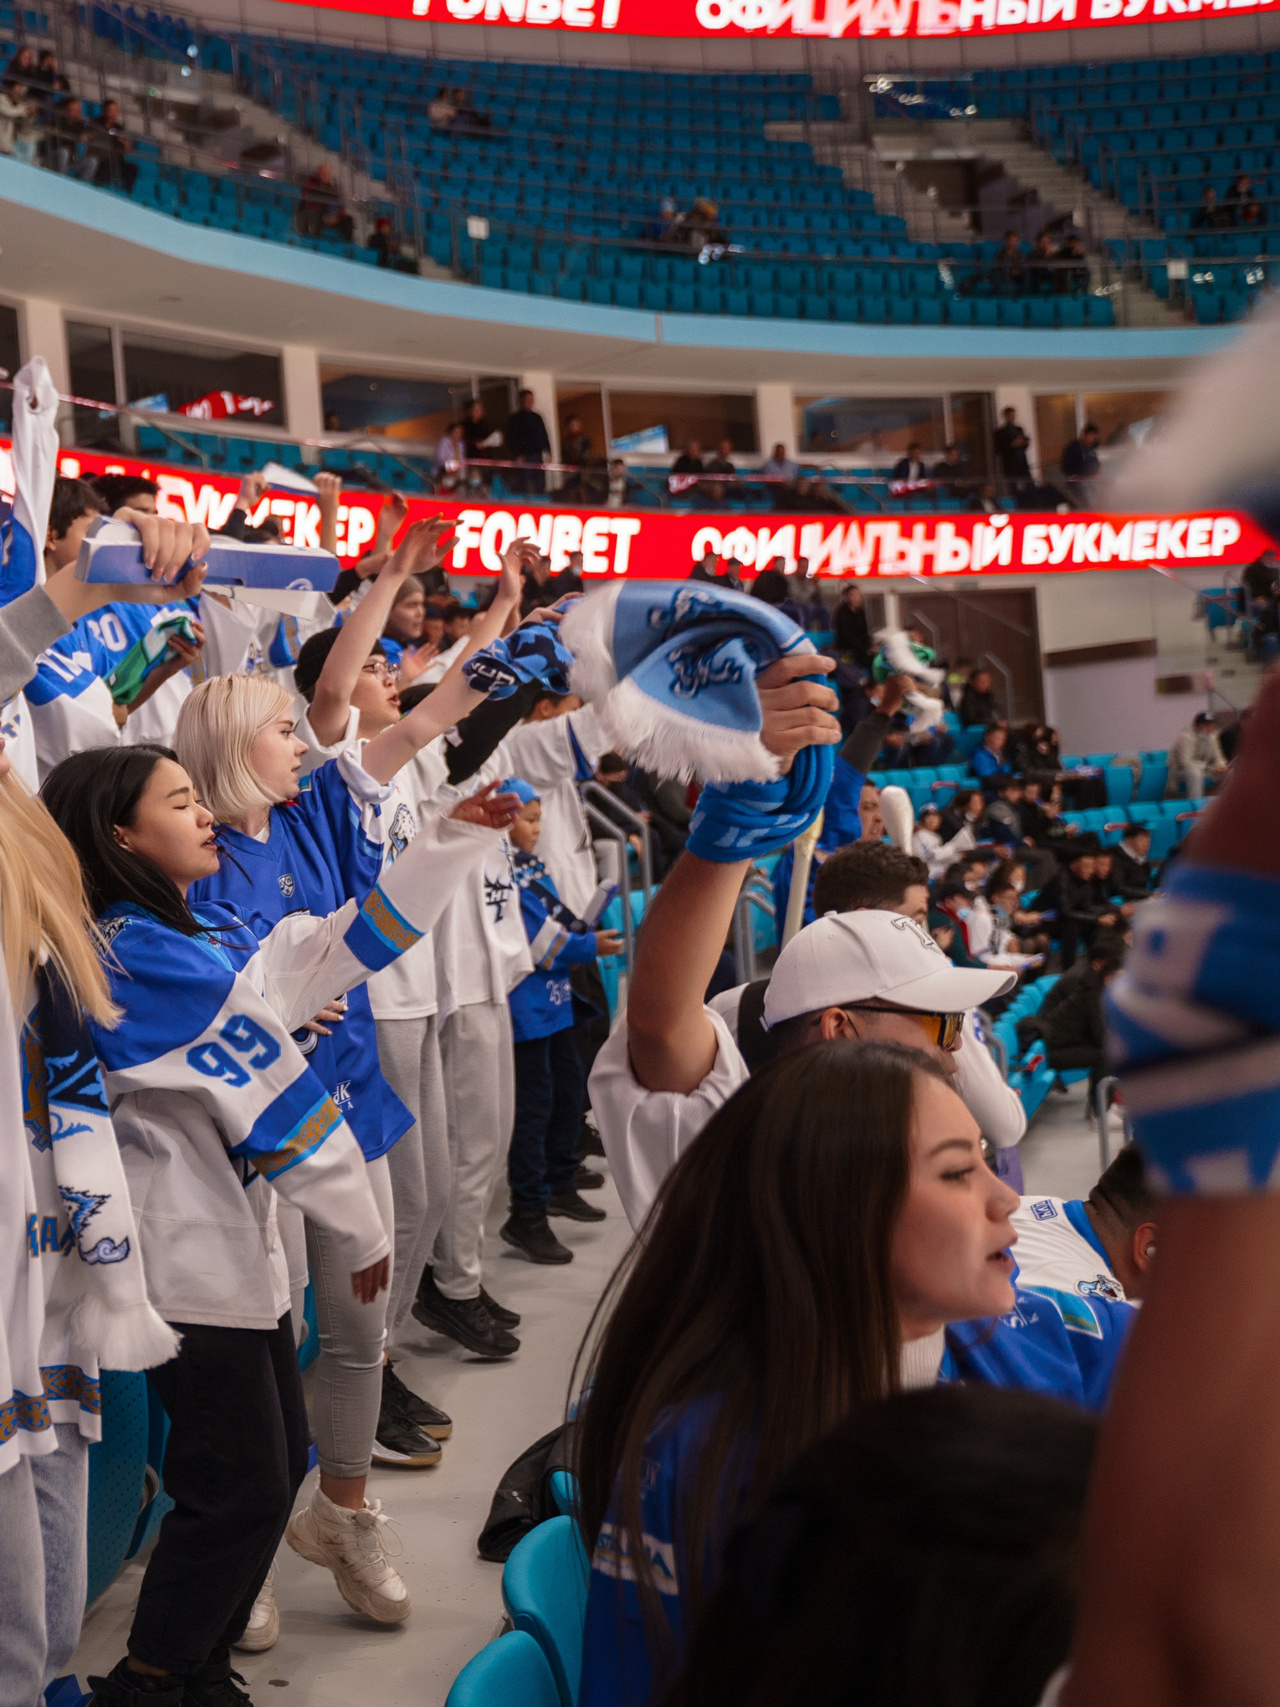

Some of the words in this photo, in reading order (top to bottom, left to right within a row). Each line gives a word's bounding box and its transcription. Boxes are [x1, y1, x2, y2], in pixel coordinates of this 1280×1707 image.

[452, 508, 642, 575] FONBET
[1021, 516, 1242, 566] БУКМЕКЕР
[186, 1013, 282, 1089] 99
